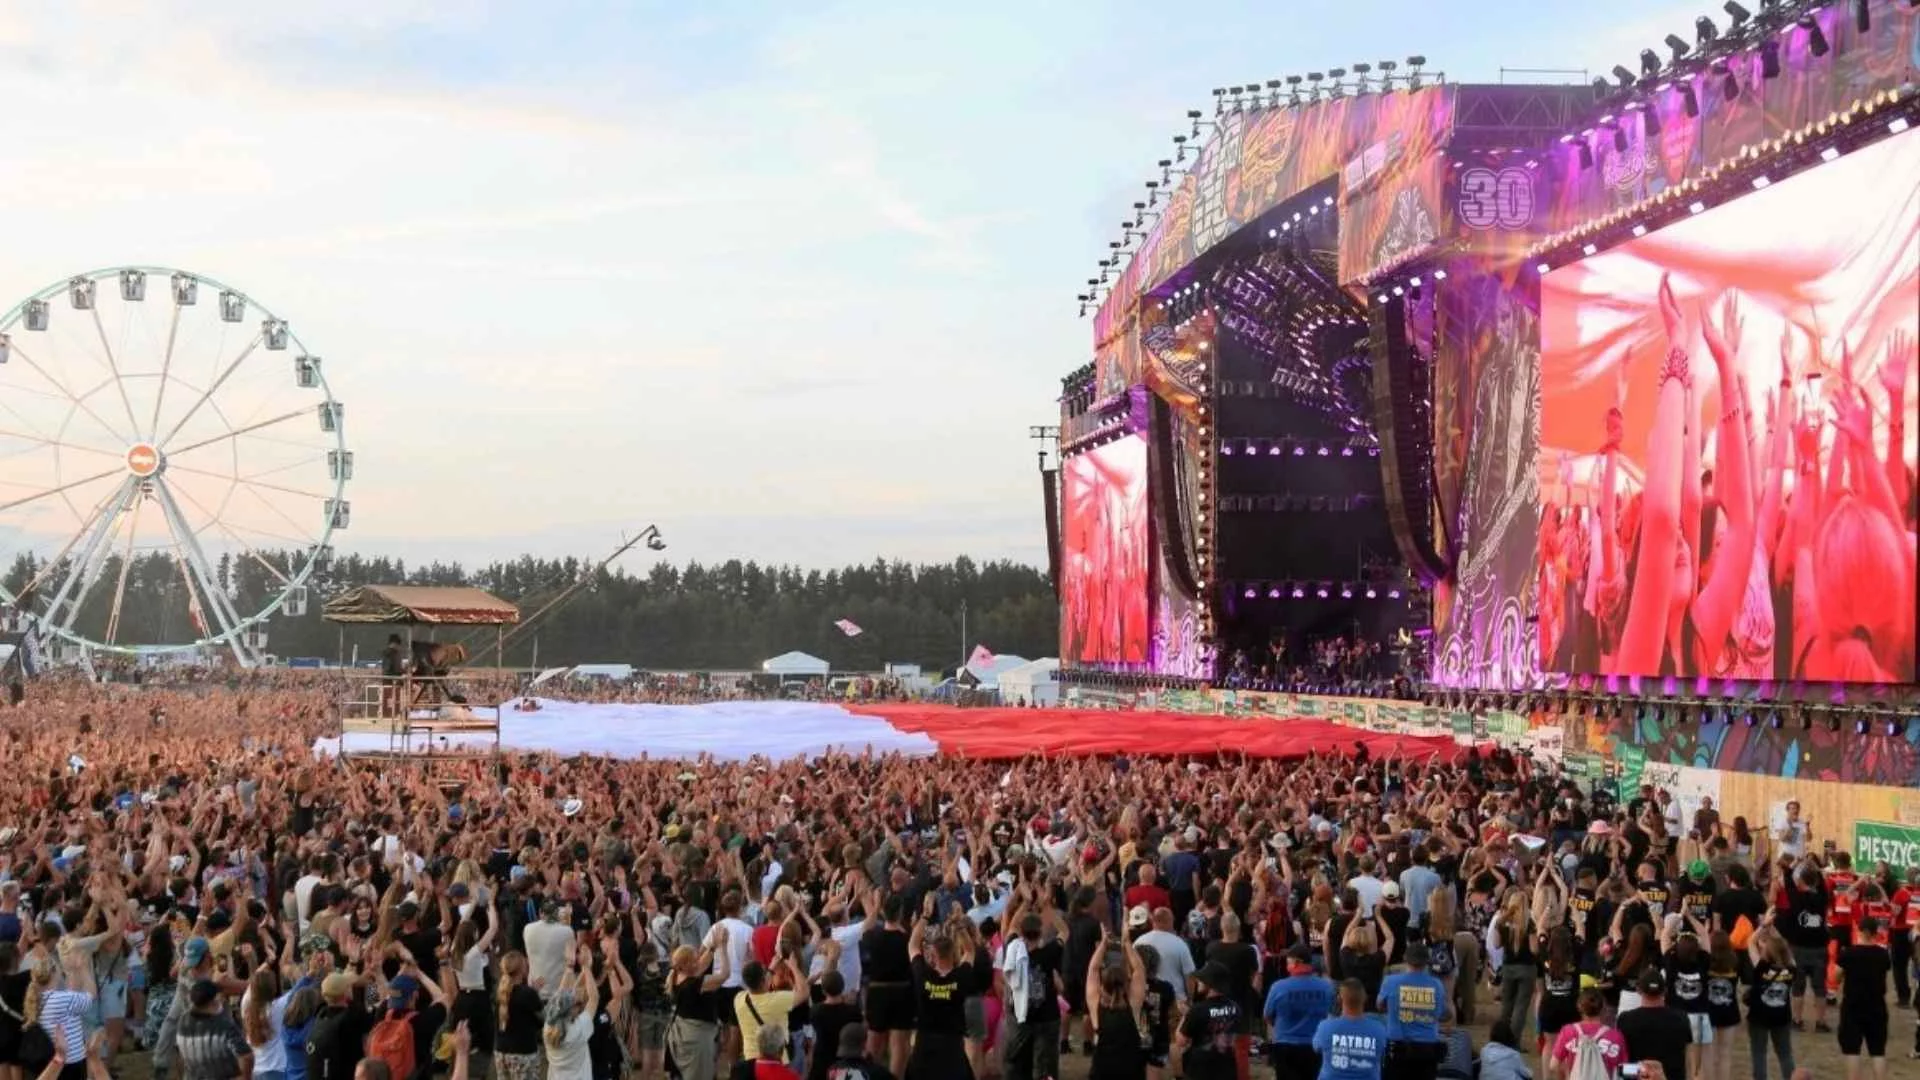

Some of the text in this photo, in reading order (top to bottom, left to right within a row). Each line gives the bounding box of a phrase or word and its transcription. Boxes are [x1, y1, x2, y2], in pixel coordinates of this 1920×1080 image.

[1460, 168, 1535, 231] 30
[1858, 835, 1919, 868] PIESZYC
[1400, 990, 1435, 1004] PATROL
[1332, 1034, 1376, 1049] PATROL
